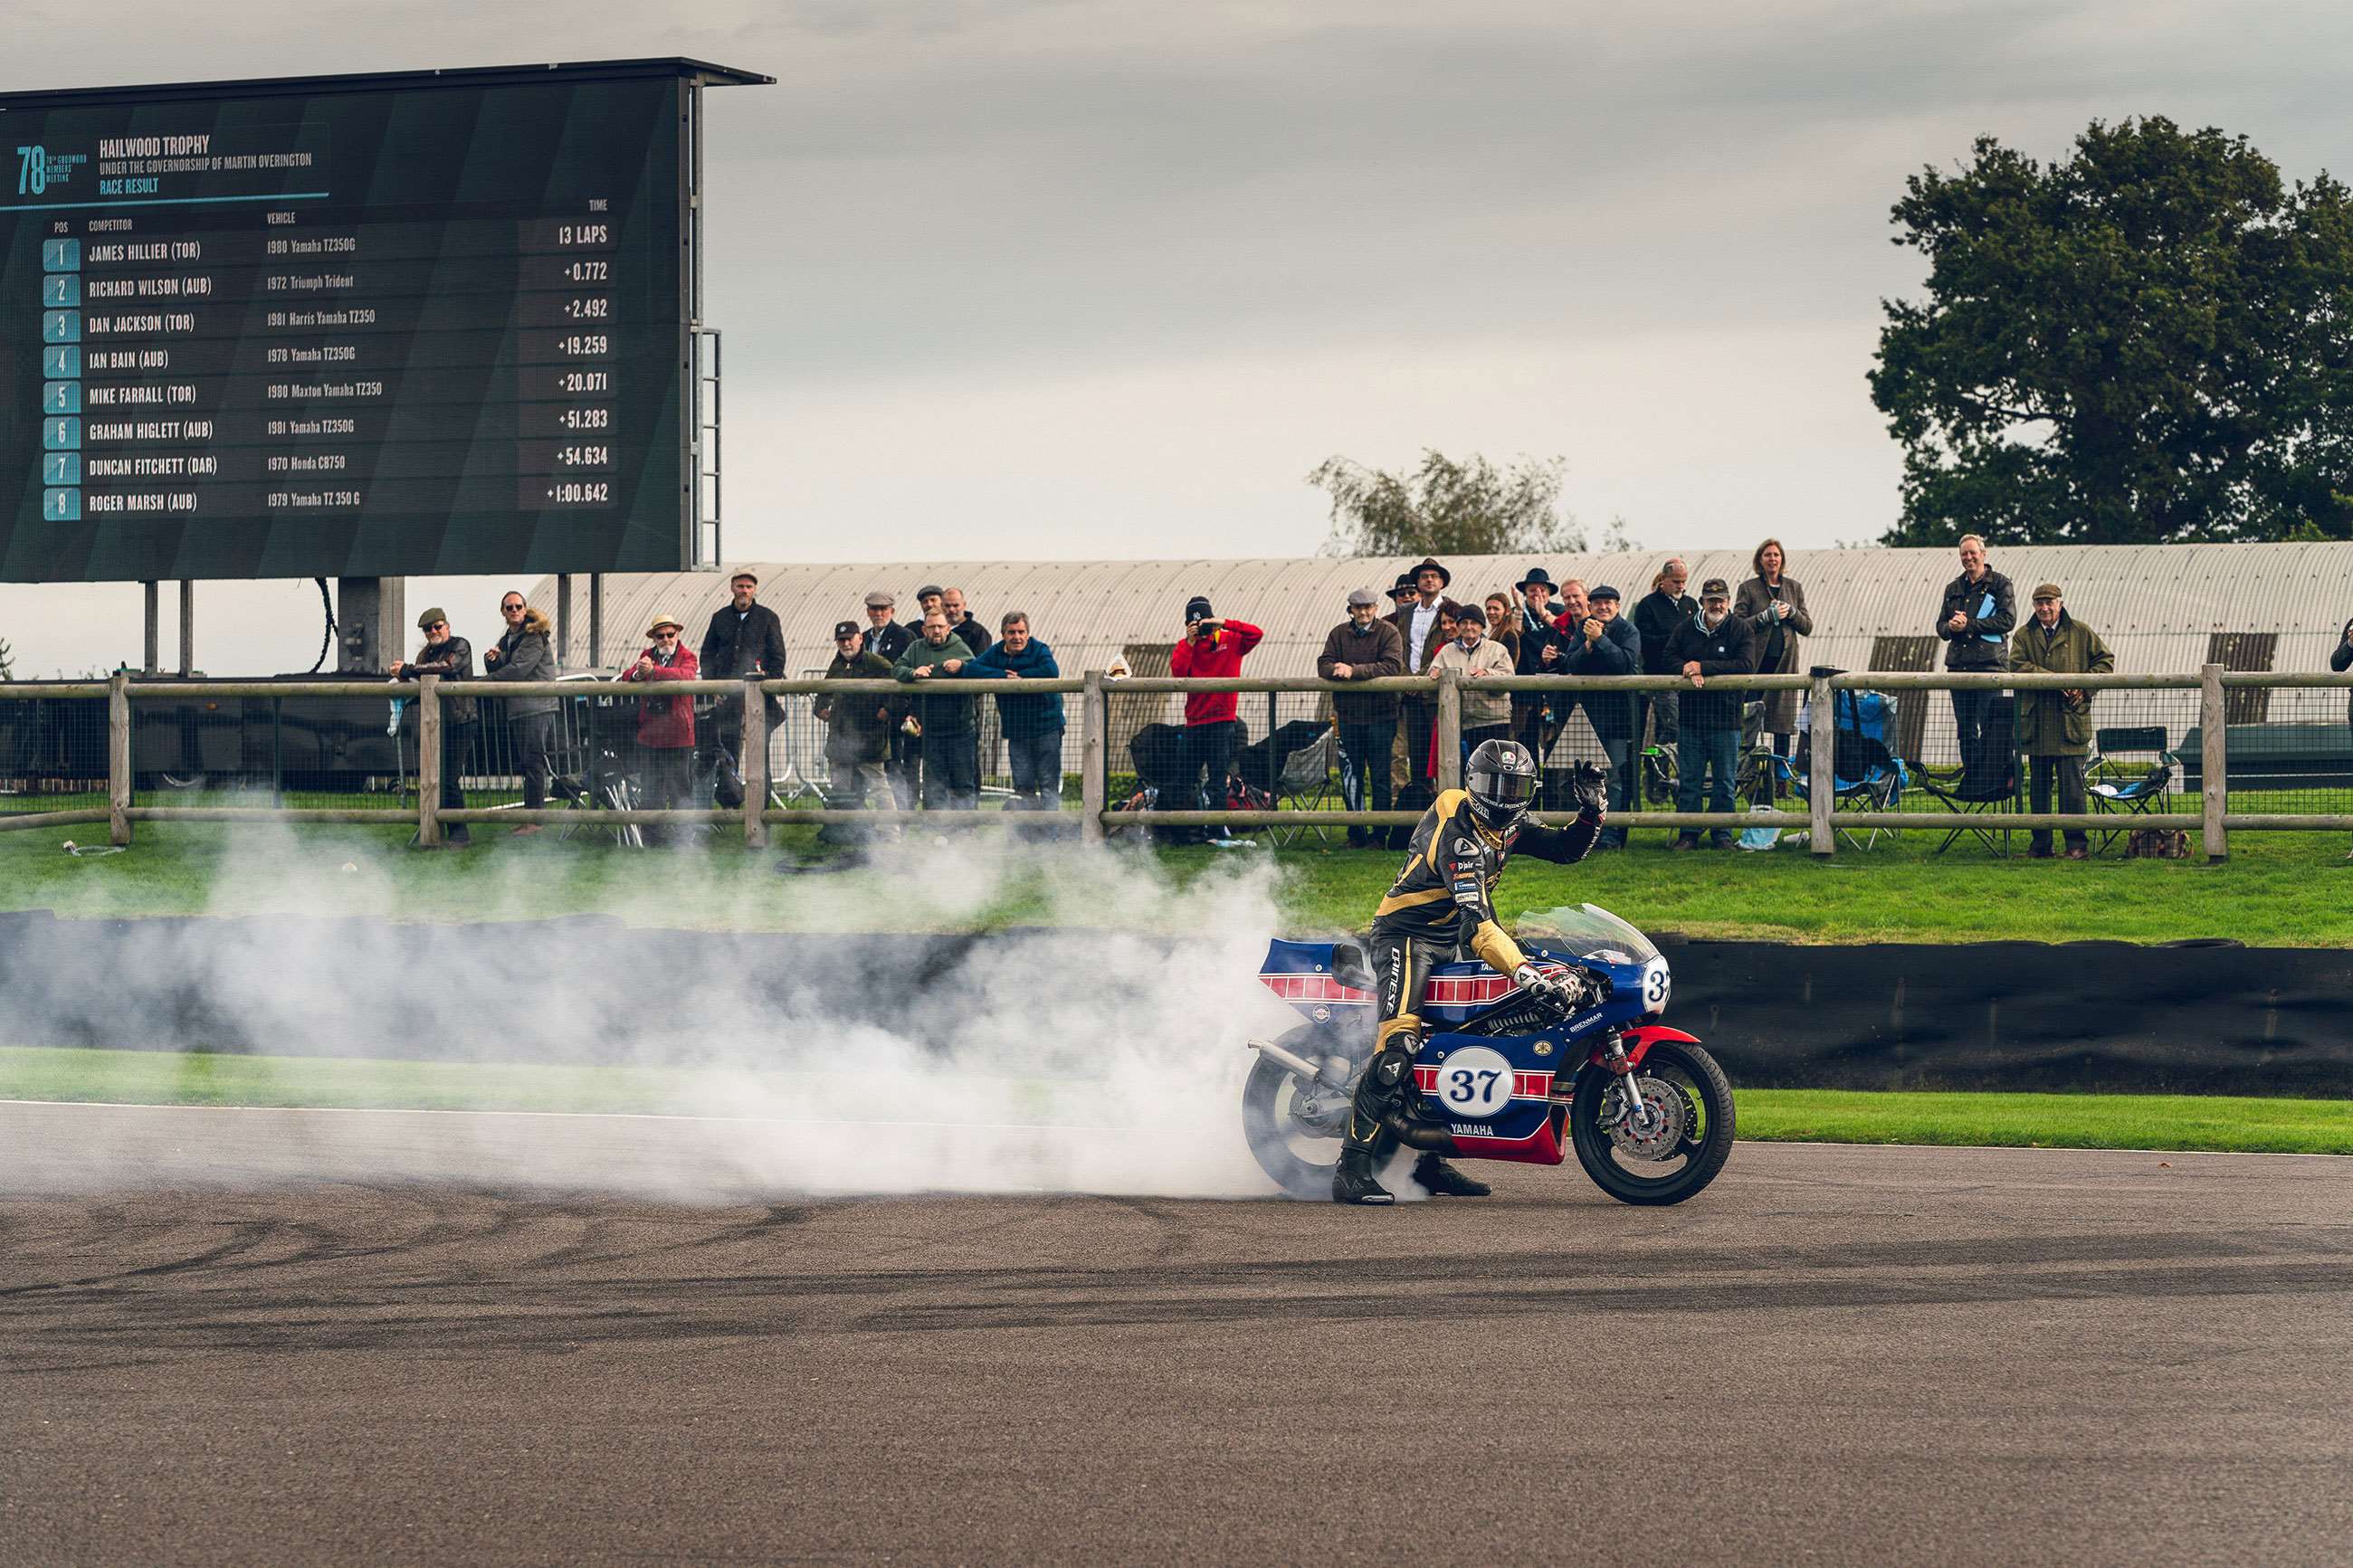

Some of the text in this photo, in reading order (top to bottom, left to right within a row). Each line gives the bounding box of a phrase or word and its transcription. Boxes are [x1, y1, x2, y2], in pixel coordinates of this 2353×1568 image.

[100, 134, 210, 159] HAILWOOD TROPHY
[16, 145, 45, 195] 78
[100, 153, 311, 176] UNDER THE GOVERNORSHIP OF MARTIN OVERINGTON
[100, 177, 158, 195] RACE RESULT
[589, 199, 608, 211] TIME
[54, 221, 69, 233] POS
[89, 219, 133, 232] COMPETITOR
[267, 212, 295, 224] VEHICLE
[559, 225, 607, 244] 13 LAPS
[60, 244, 63, 265] 1
[90, 241, 200, 261] JAMES HILLIER (TOR)
[268, 240, 287, 253] 1980
[291, 239, 321, 253] Yamaha
[565, 262, 607, 280] +0.772
[59, 280, 65, 301] 2
[90, 276, 211, 297] RICHARD WILSON (AUB)
[268, 275, 353, 291] 1972 Triumph Trident
[268, 309, 376, 326] 1981 Harris Yamaha TZ350
[565, 299, 607, 318] +2.492
[59, 316, 65, 336] 3
[90, 313, 195, 333] DAN JACKSON (TOR)
[268, 349, 287, 362] 1978
[291, 347, 321, 361] Yamaha
[559, 336, 607, 355] +19.259
[58, 351, 65, 371] 4
[90, 349, 168, 369] IAN BAIN (AUB)
[268, 382, 382, 398] 1980 Maxton Yamaha TZ350
[558, 373, 607, 391] +20.071
[59, 386, 65, 407] 5
[90, 385, 196, 404] MIKE FARRALL (TOR)
[268, 421, 286, 434] 1981
[290, 421, 319, 434] Yamaha
[559, 409, 608, 428] +51.283
[59, 422, 65, 442] 6
[90, 420, 213, 440] GRAHAM HIGLETT (AUB)
[268, 455, 346, 470] 1970 Honda CB750
[557, 446, 608, 465] +54.634
[59, 458, 66, 479] 7
[90, 455, 217, 476] DUNCAN FITCHETT (DAR)
[90, 493, 197, 511] ROGER MARSH (AUB)
[268, 494, 288, 507] 1979
[291, 493, 321, 507] Yamaha
[323, 492, 333, 506] TZ
[336, 491, 351, 505] 350
[548, 483, 608, 502] +1:00.642
[59, 493, 66, 514] 8
[1386, 947, 1400, 1013] DAINESE
[1569, 1012, 1603, 1032] BRENMAR
[1450, 1069, 1501, 1103] 37
[1451, 1124, 1493, 1136] YAMAHA
